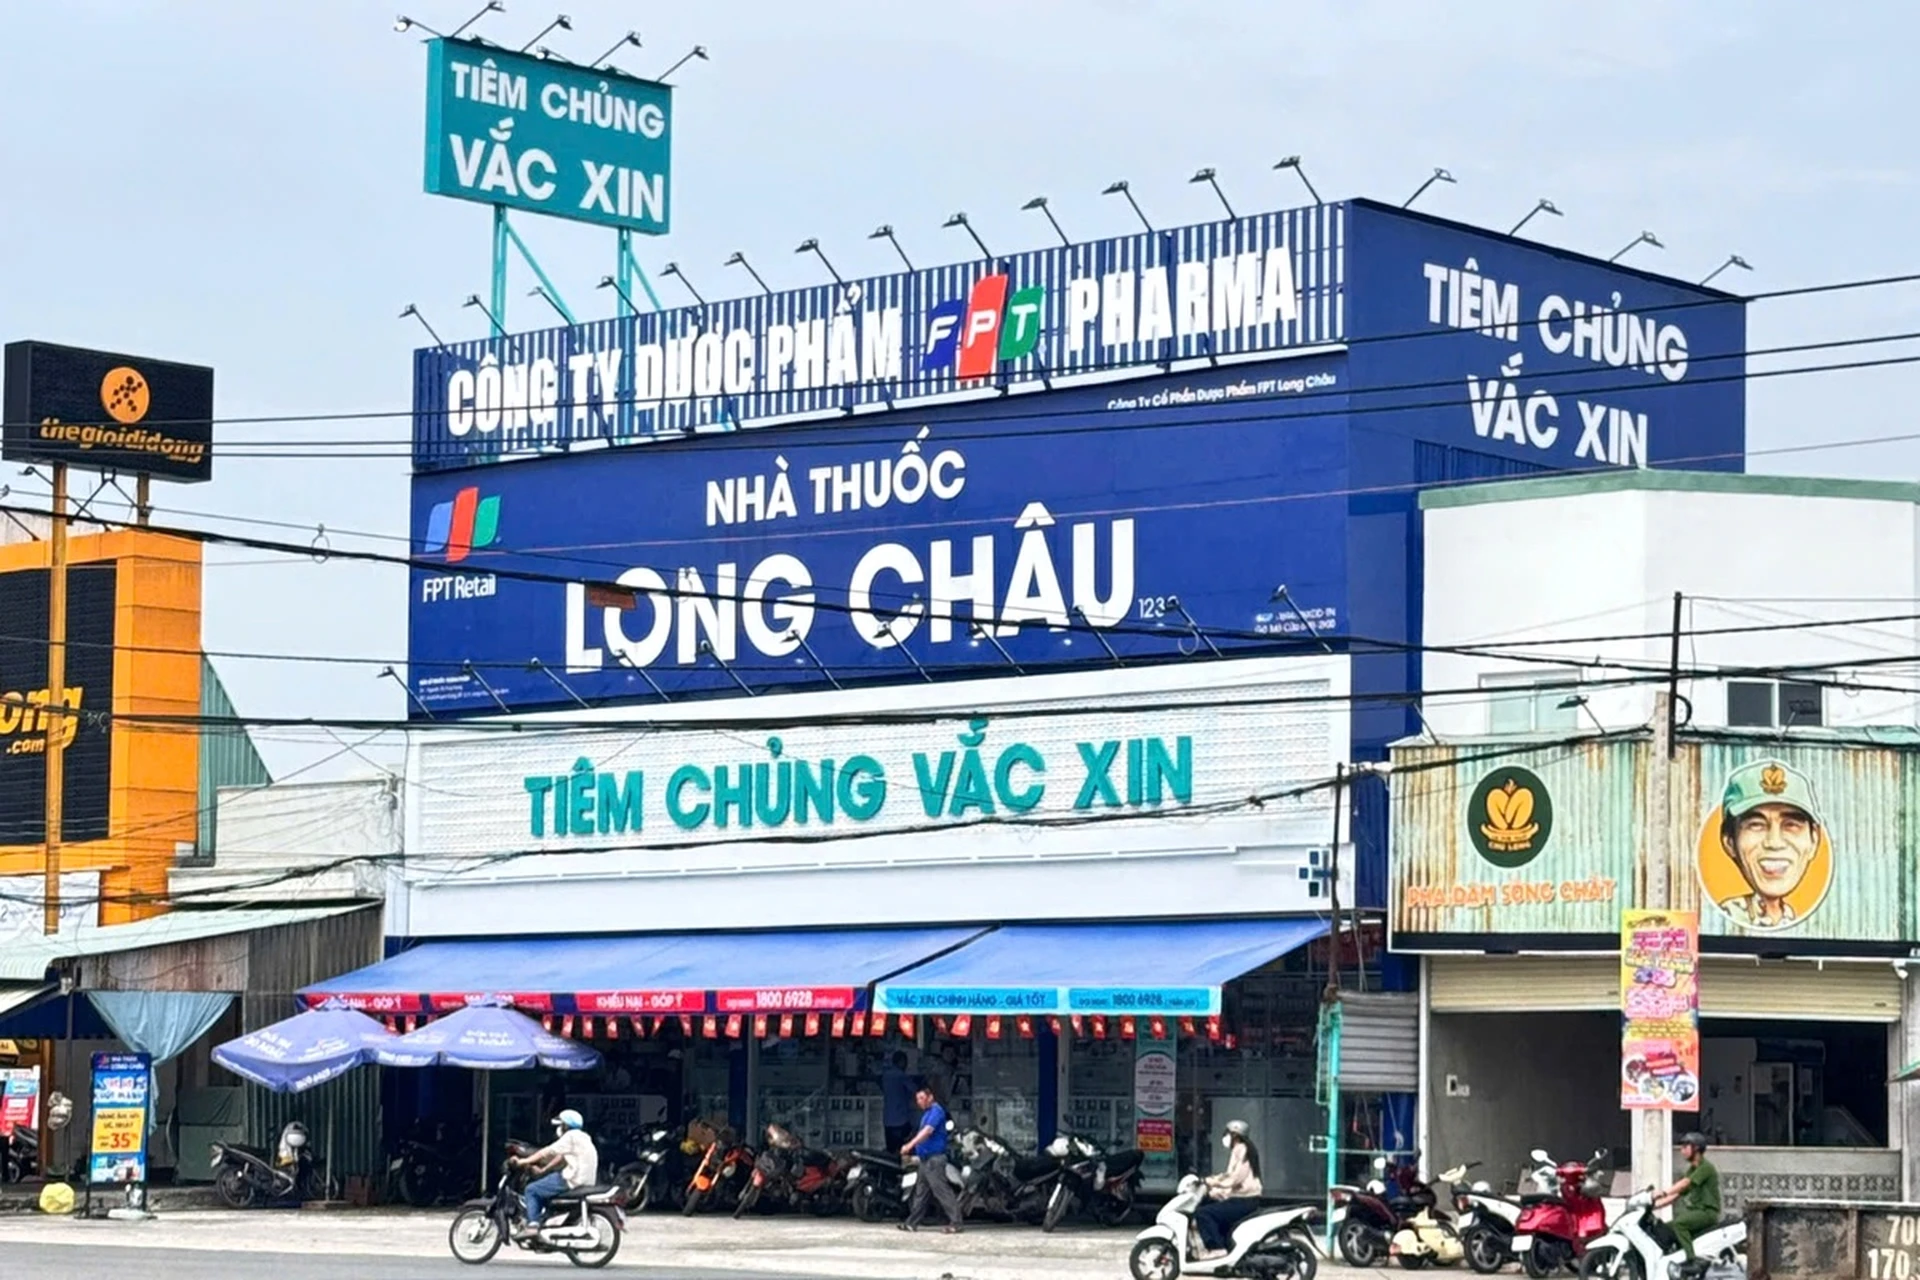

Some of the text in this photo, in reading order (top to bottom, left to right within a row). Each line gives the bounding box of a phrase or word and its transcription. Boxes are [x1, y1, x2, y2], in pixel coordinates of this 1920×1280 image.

[451, 58, 665, 139] TIÊM CHỦNG
[449, 117, 664, 223] VẮC XIN
[448, 246, 1297, 436] CÔNG TY DƯỢC PHẨM FPT PHARMA
[1423, 257, 1688, 382] TIÊM CHỦNG
[1257, 379, 1276, 393] FPT
[1277, 377, 1304, 392] Long
[1305, 372, 1336, 388] Châu
[1467, 352, 1648, 469] VẮC XIN
[40, 417, 204, 464] thegioididong
[706, 425, 966, 526] NHÀ THUỐC
[423, 573, 496, 603] FPT Retail
[566, 502, 1136, 674] LONG CHÂU
[524, 717, 1193, 838] TIÊM CHỦNG VẮC XIN
[756, 989, 782, 1008] 1800
[784, 989, 813, 1008] 6928
[1886, 1215, 1920, 1245] 70
